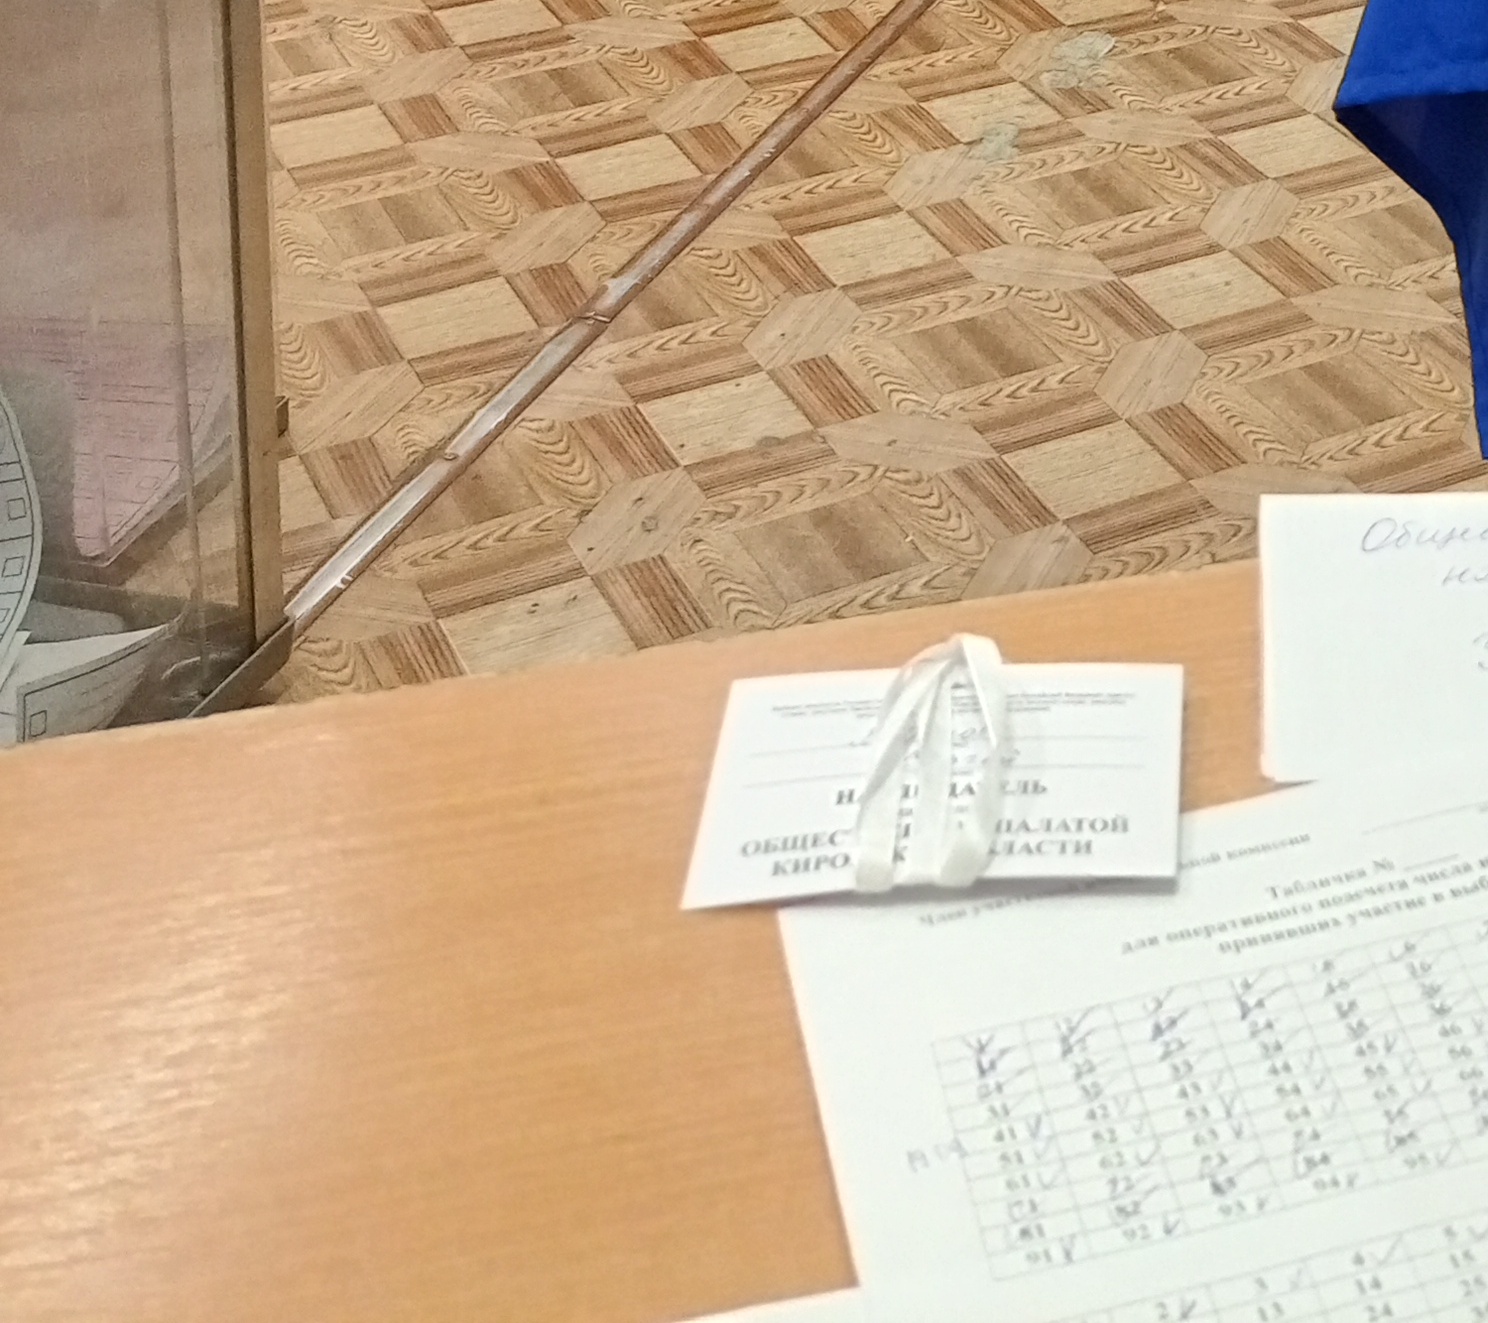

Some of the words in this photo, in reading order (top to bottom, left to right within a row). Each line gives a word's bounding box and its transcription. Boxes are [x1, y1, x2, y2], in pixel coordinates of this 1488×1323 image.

[1121, 934, 1160, 955] для
[1165, 903, 1314, 941] оперативного
[1317, 878, 1410, 909] подсчета
[1413, 861, 1475, 885] числа
[1266, 866, 1368, 900] Табличка
[1218, 916, 1342, 954] принявших
[1346, 895, 1428, 927] участие
